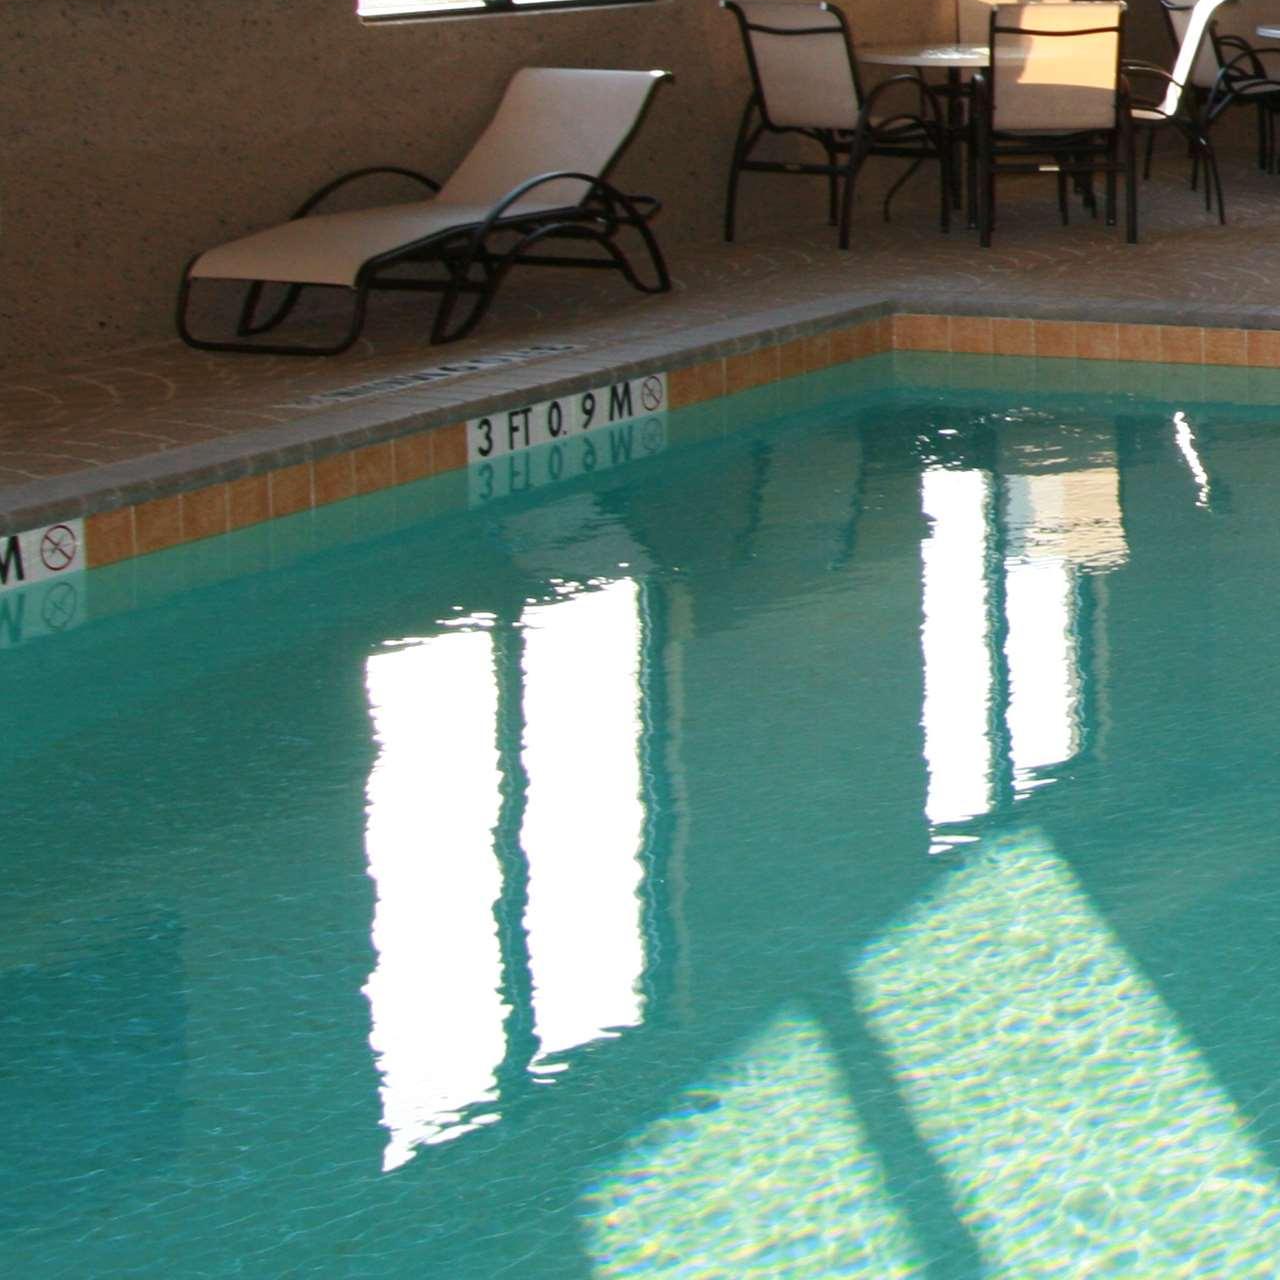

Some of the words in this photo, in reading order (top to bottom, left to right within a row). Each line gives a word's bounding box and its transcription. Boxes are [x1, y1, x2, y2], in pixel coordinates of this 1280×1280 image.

[478, 418, 493, 457] 3
[508, 407, 532, 450] FT
[609, 381, 633, 421] M
